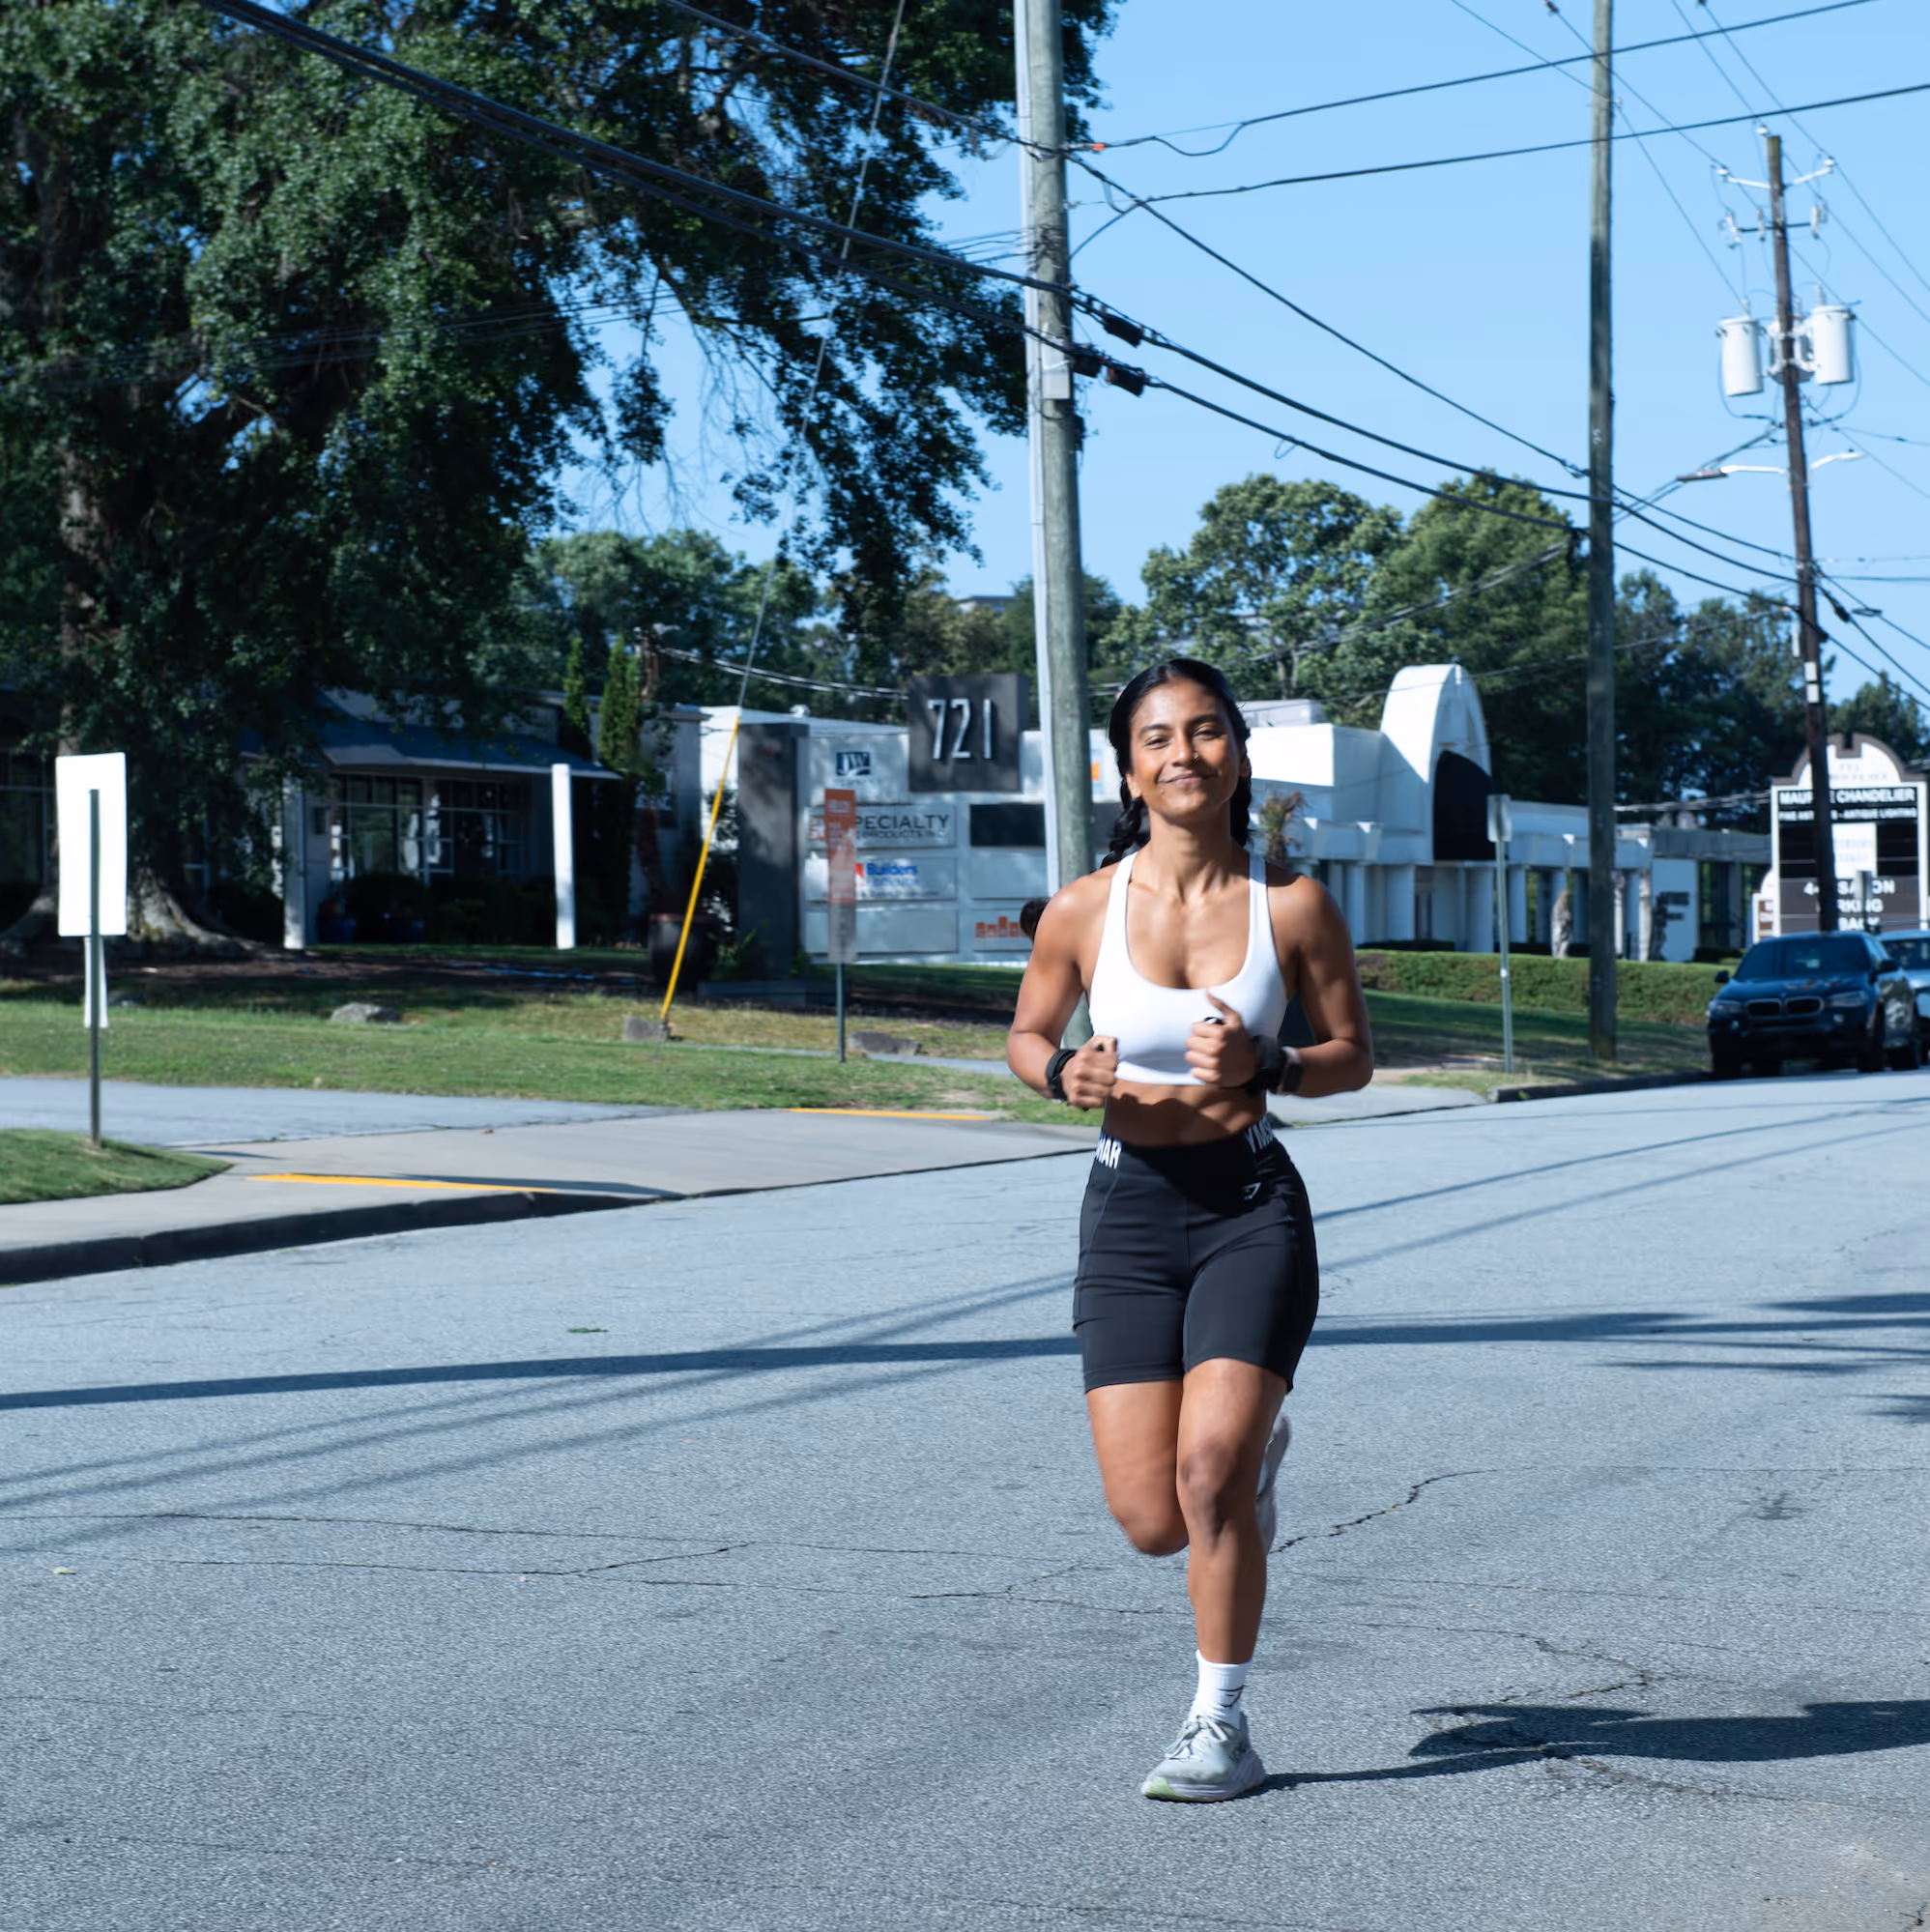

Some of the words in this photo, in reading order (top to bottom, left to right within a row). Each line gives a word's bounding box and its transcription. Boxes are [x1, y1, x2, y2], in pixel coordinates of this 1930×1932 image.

[927, 698, 992, 760] 721
[1836, 788, 1916, 803] CHANDELIER
[855, 815, 950, 829] PECIALTY
[866, 862, 918, 876] Builders
[1837, 879, 1896, 895] SAON
